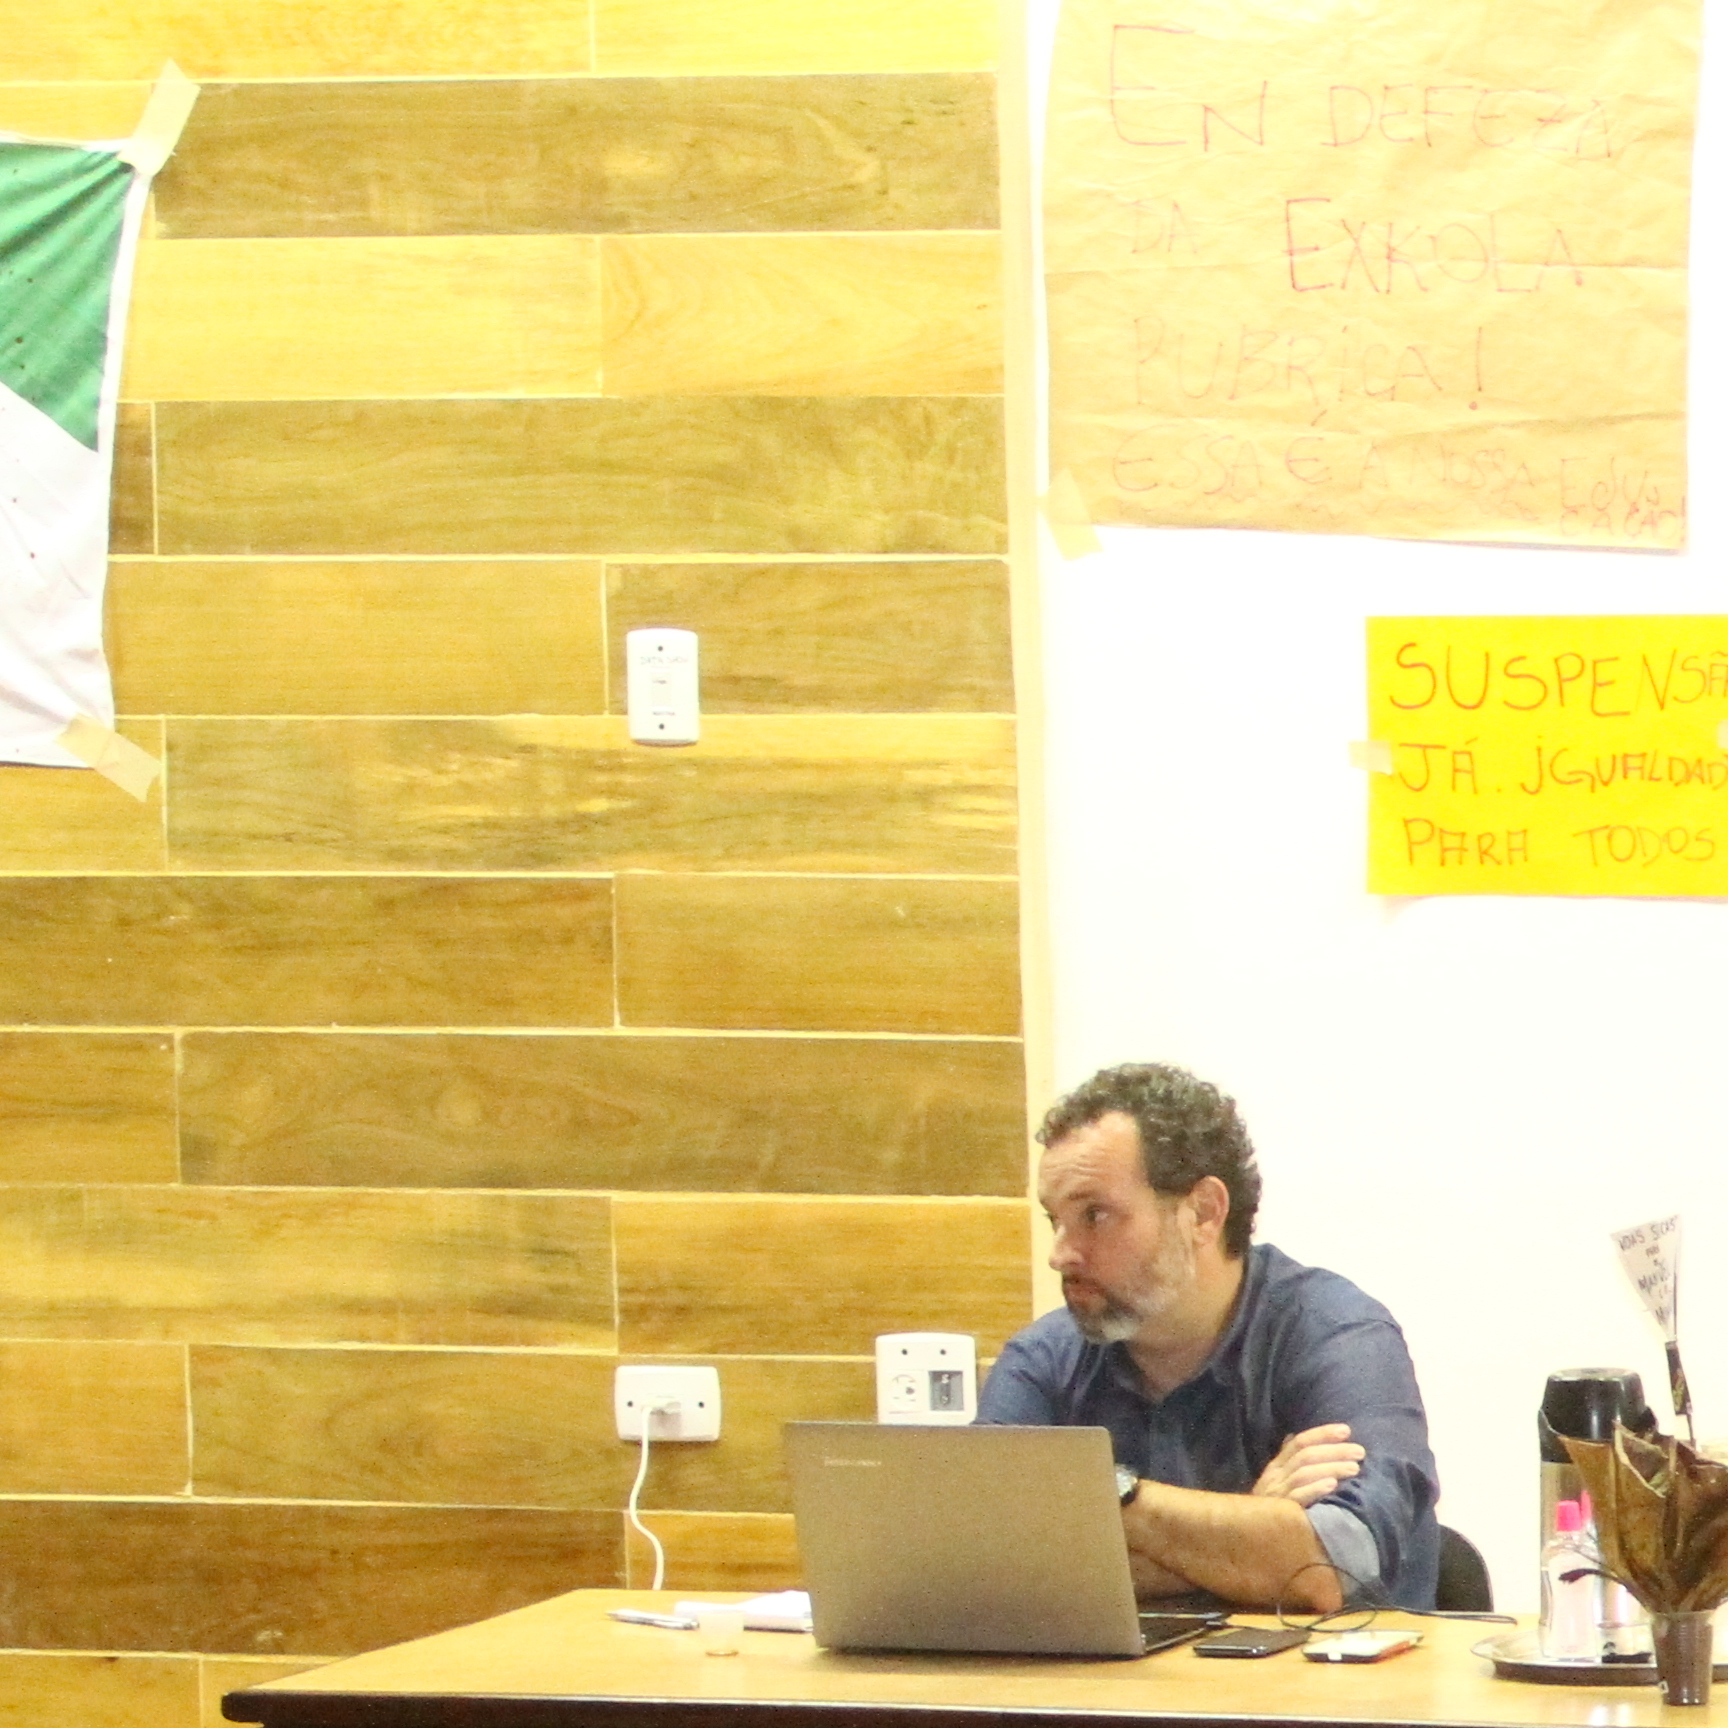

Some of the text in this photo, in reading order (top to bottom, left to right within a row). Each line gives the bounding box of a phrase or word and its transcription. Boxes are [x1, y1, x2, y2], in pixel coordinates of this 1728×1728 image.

[1128, 199, 1199, 254] DA
[1403, 818, 1716, 868] PARA TODOS
